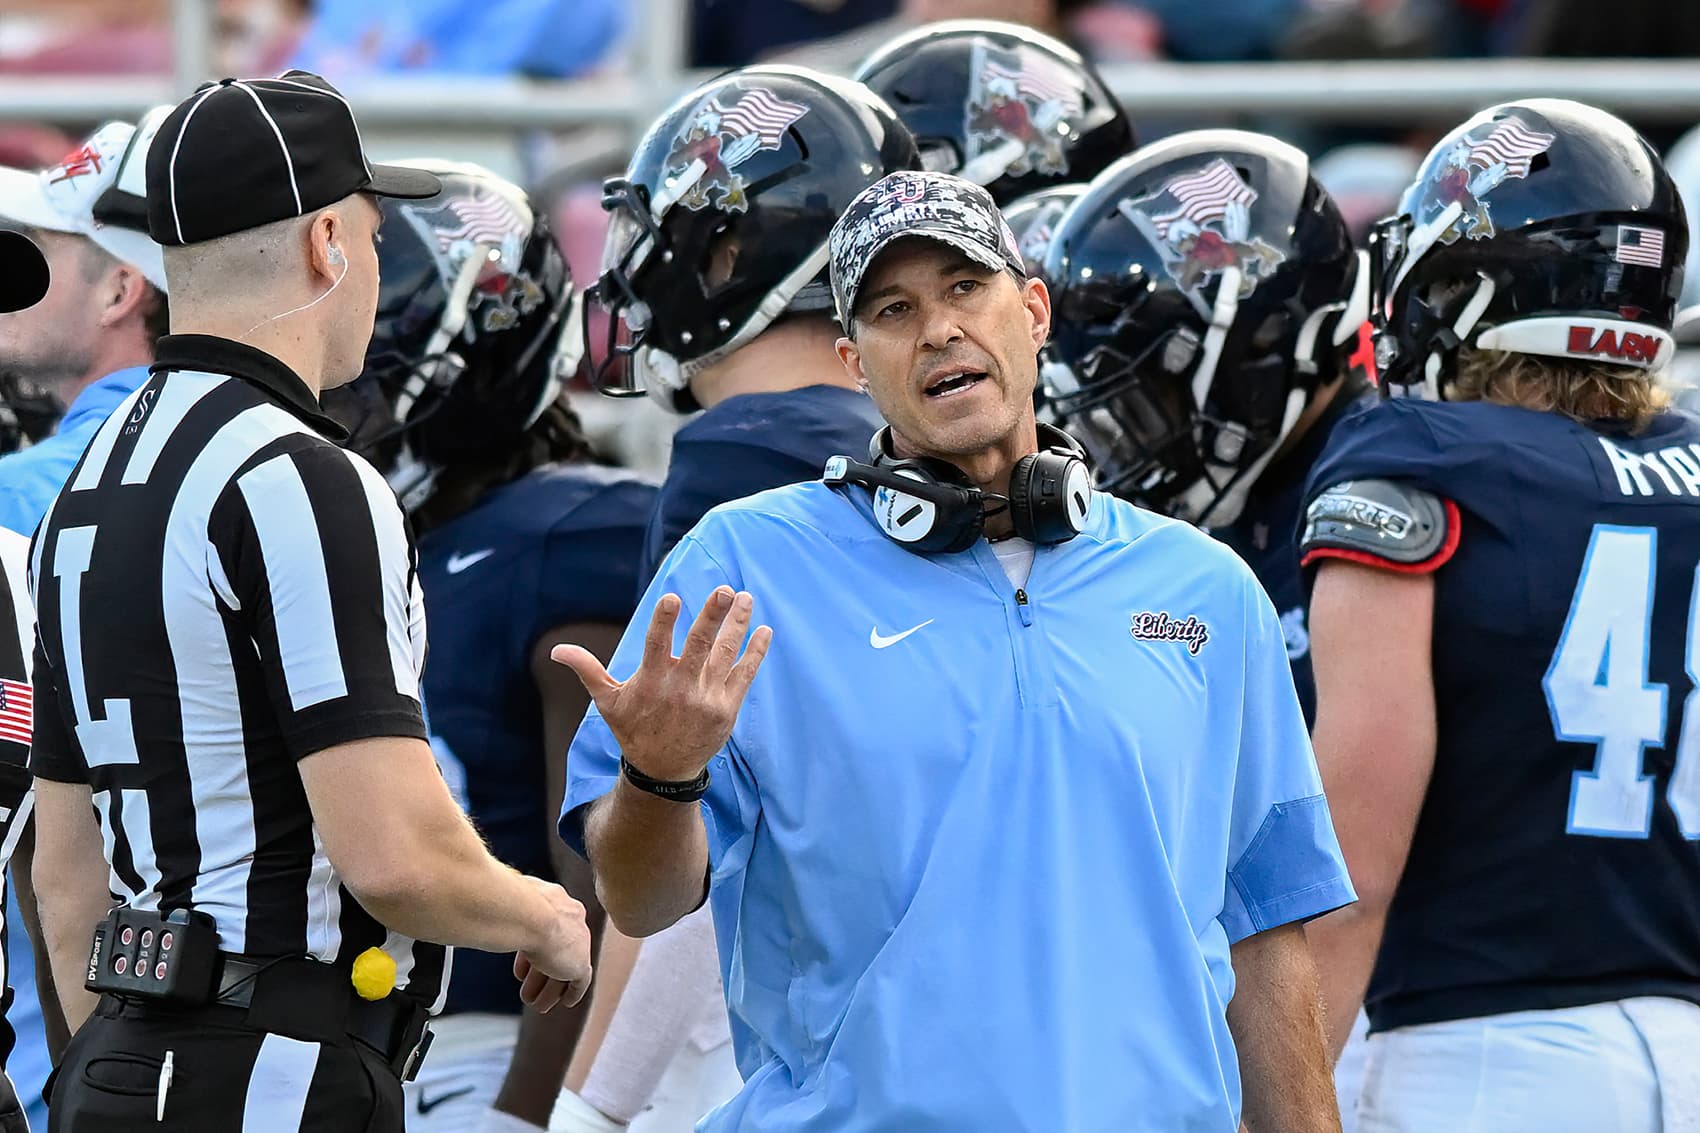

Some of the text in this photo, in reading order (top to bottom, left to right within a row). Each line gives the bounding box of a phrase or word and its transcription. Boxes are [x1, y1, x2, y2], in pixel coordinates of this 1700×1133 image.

[1567, 325, 1663, 365] EARN
[1598, 436, 1700, 497] RYA
[53, 525, 139, 768] L
[1131, 612, 1210, 657] Liberty
[87, 935, 104, 982] DVSPORT
